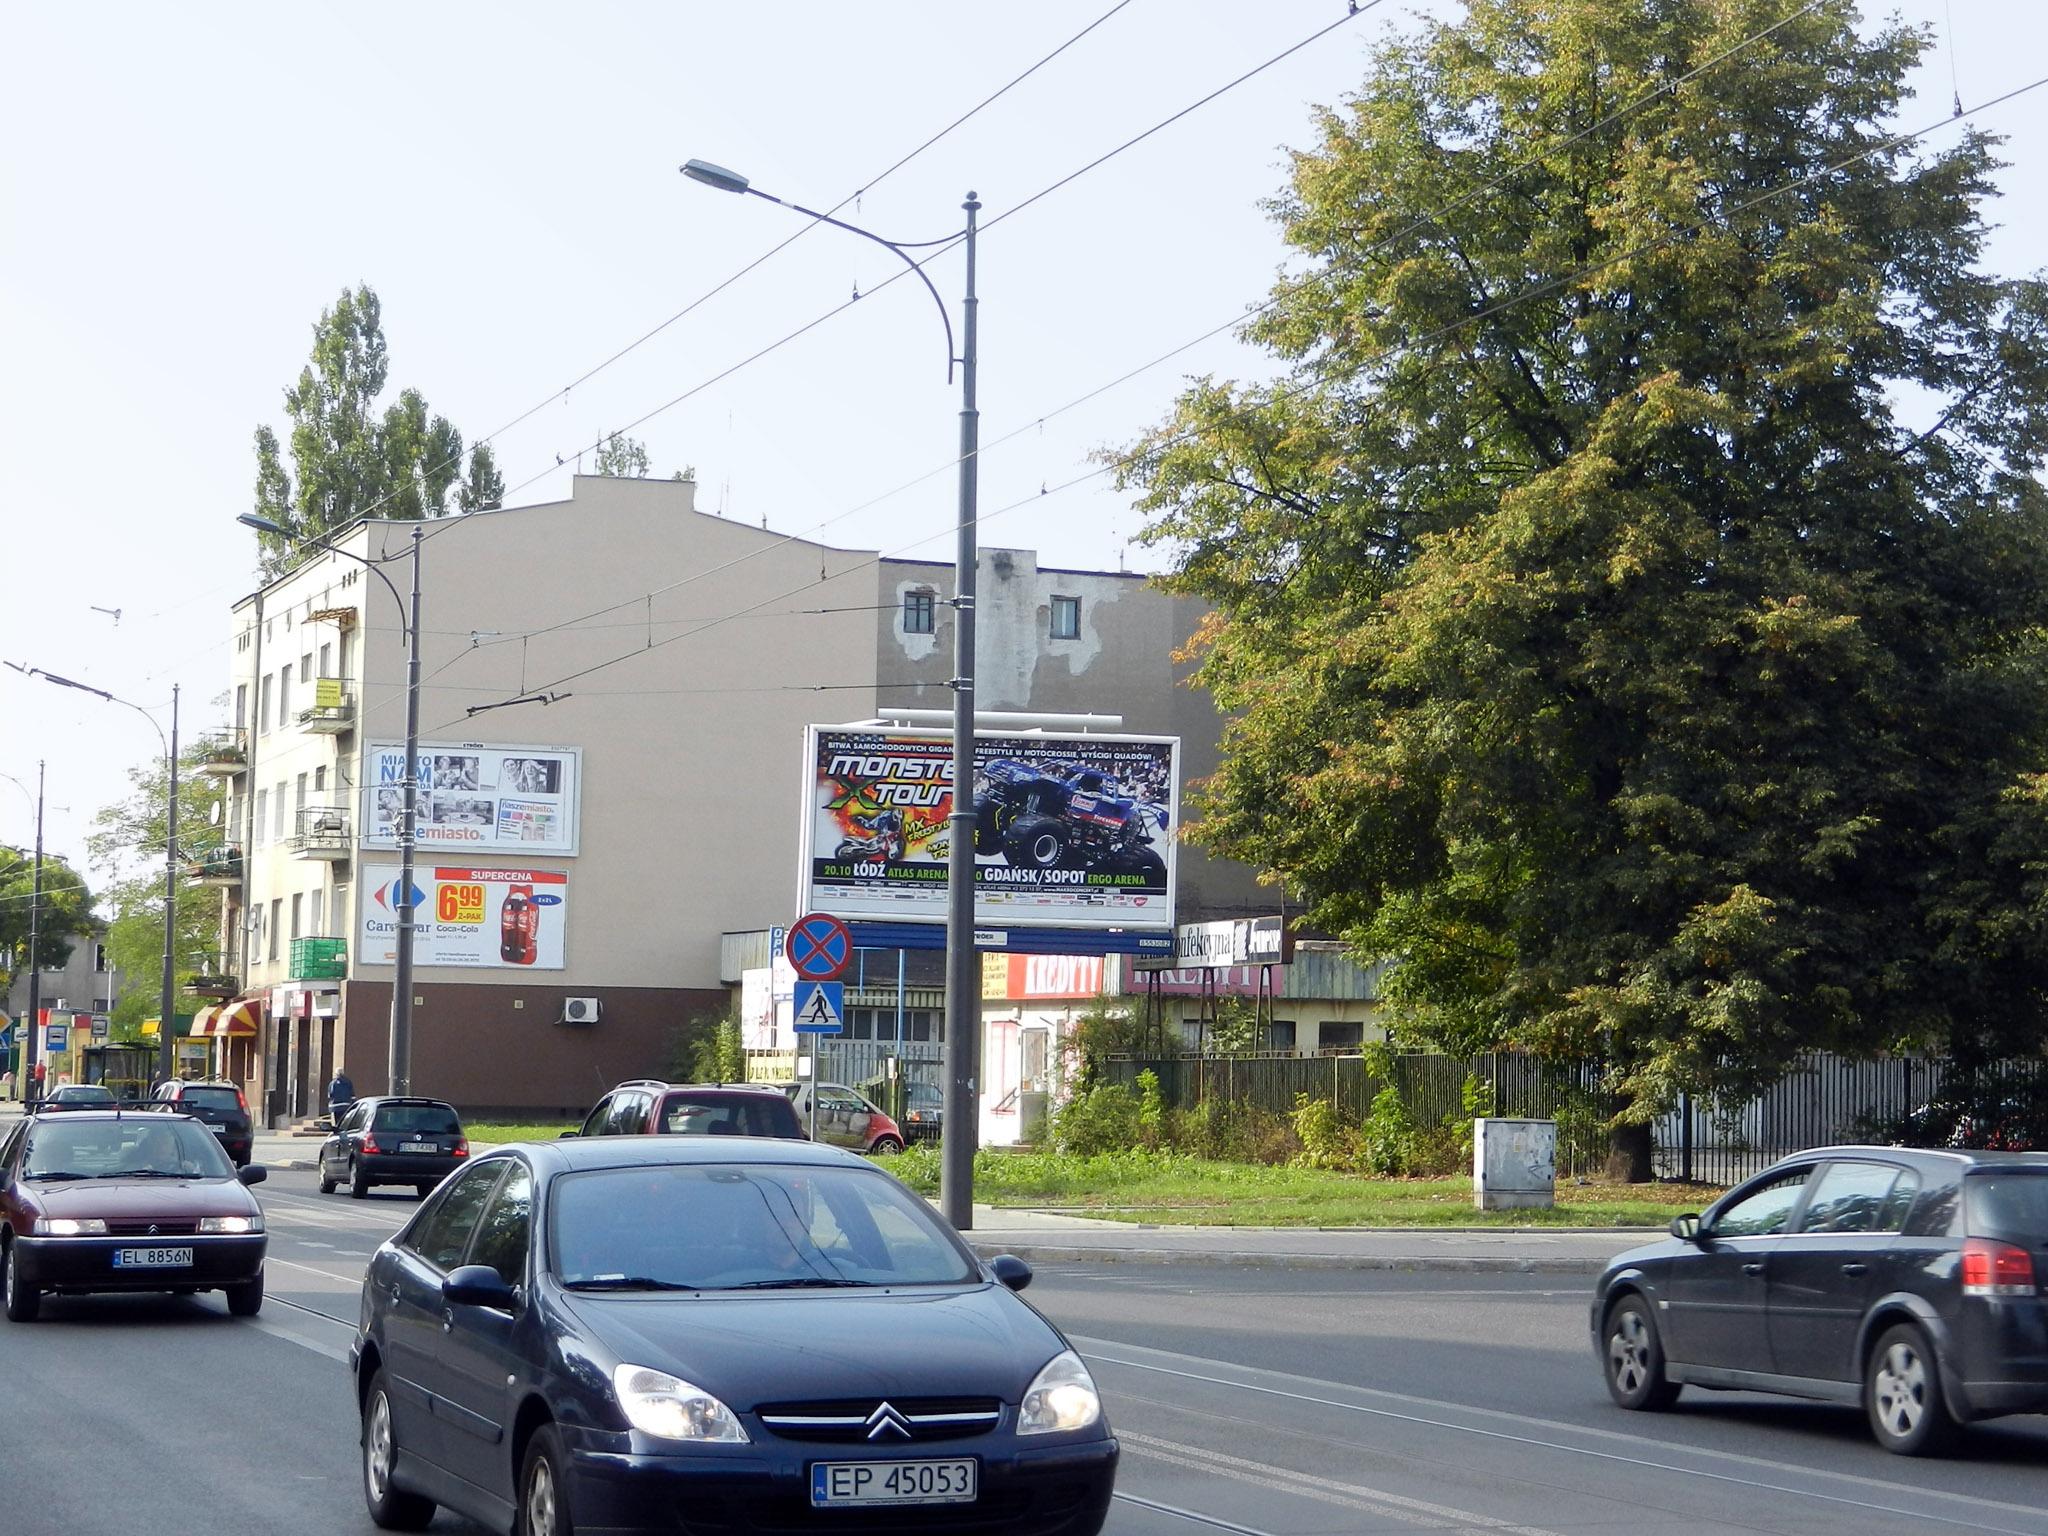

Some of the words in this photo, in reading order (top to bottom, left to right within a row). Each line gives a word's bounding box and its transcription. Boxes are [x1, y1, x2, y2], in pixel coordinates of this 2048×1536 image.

[854, 743, 927, 751] SAMOCHODOWYCH
[929, 745, 953, 753] GIGAN
[975, 747, 1014, 756] FREESTYLE
[1024, 749, 1079, 758] MOTOCROSSIE,
[1081, 750, 1112, 760] WYŚCIGI
[1114, 751, 1152, 761] QUADÓW!
[382, 755, 432, 767] MIATO
[904, 817, 925, 834] MX
[471, 871, 533, 881] SUPERCENA
[824, 865, 850, 875] 20.10
[853, 860, 885, 877] ŁÓDŹ
[887, 868, 915, 878] ATLAS
[916, 869, 948, 879] ARENA
[984, 865, 1086, 885] GDAŃSK/SOPOT
[1087, 874, 1112, 884] ERGO
[1114, 875, 1146, 885] ARENA
[436, 925, 479, 933] Coca-Cola
[1173, 927, 1231, 962] onfekcyjna
[1025, 955, 1100, 994] KREDYTY
[122, 1250, 142, 1264] EL
[147, 1249, 191, 1264] 8856N
[832, 1467, 872, 1497] EP
[884, 1464, 968, 1495] 45053
